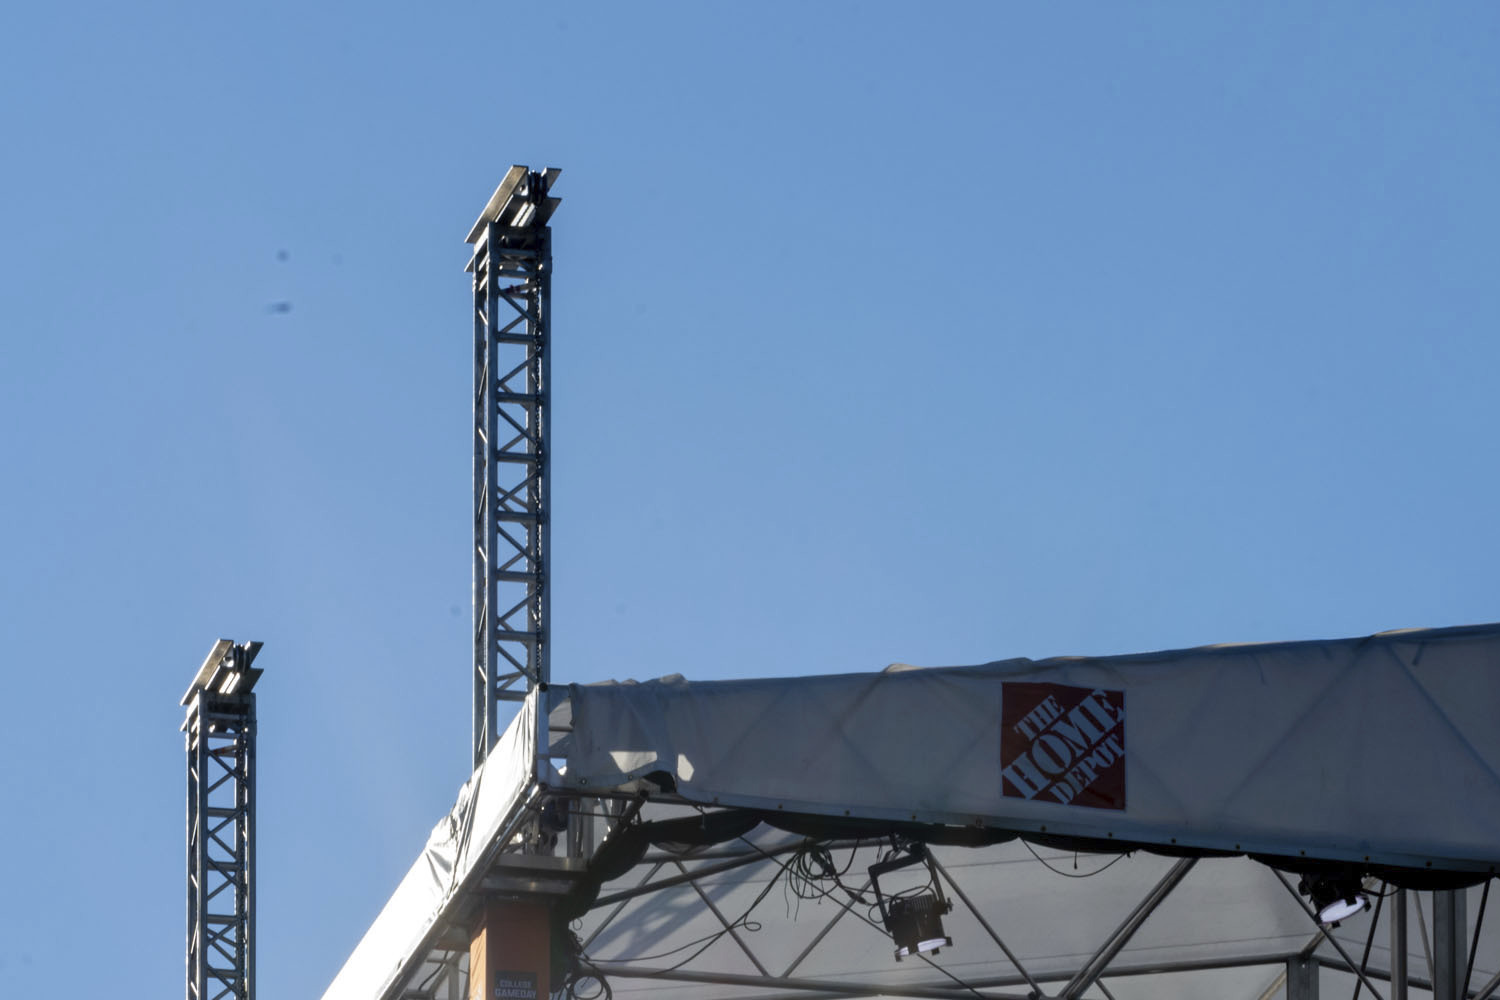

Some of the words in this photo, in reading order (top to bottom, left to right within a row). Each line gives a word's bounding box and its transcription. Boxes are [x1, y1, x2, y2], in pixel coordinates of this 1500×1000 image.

[1014, 694, 1065, 742] THE
[1002, 689, 1126, 800] HOME
[1048, 731, 1125, 806] DEPOT
[494, 988, 536, 999] GAMEDAY
[499, 979, 531, 989] COLLEGE
